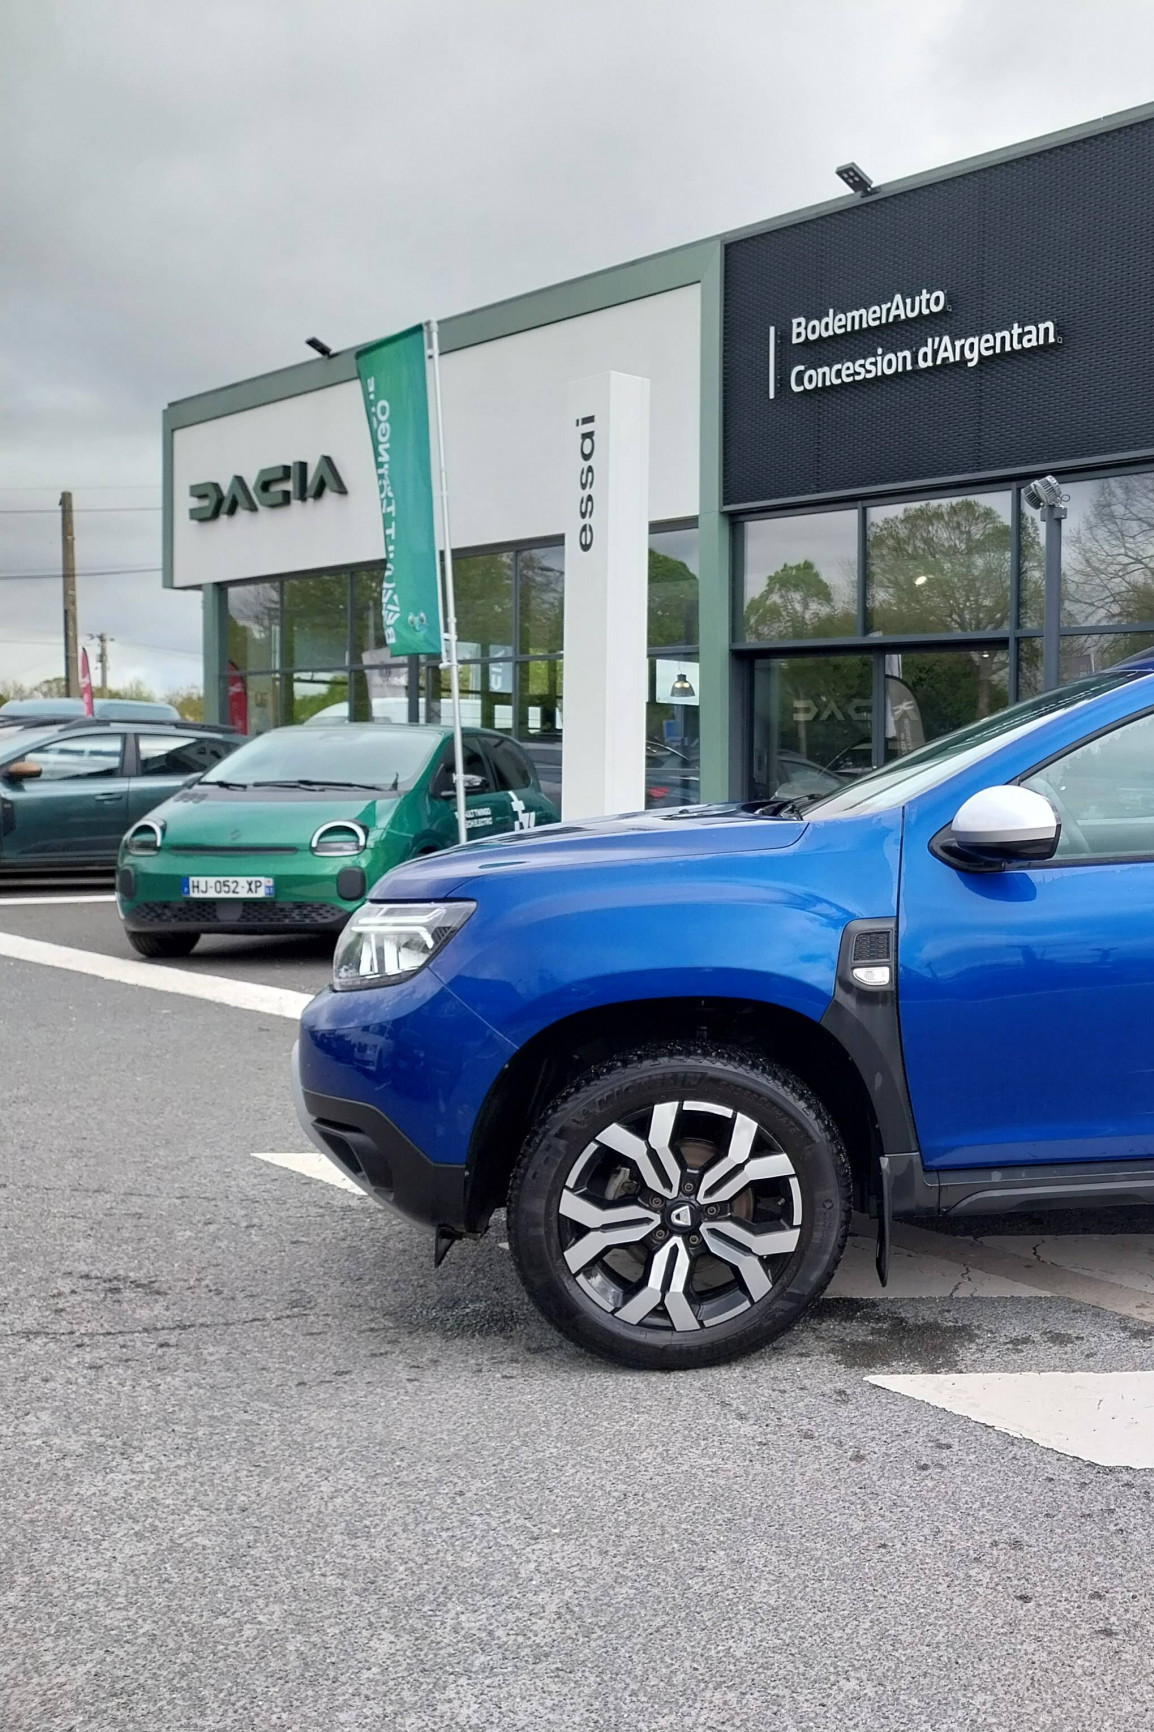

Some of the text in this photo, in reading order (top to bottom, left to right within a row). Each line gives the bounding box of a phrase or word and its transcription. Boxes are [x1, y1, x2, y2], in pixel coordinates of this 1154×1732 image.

[791, 288, 945, 344] BodemerAuto
[790, 320, 1055, 392] Concession d'Argentan
[189, 454, 348, 522] DACIA
[576, 415, 595, 552] essai
[191, 880, 263, 894] HJ-052-XP
